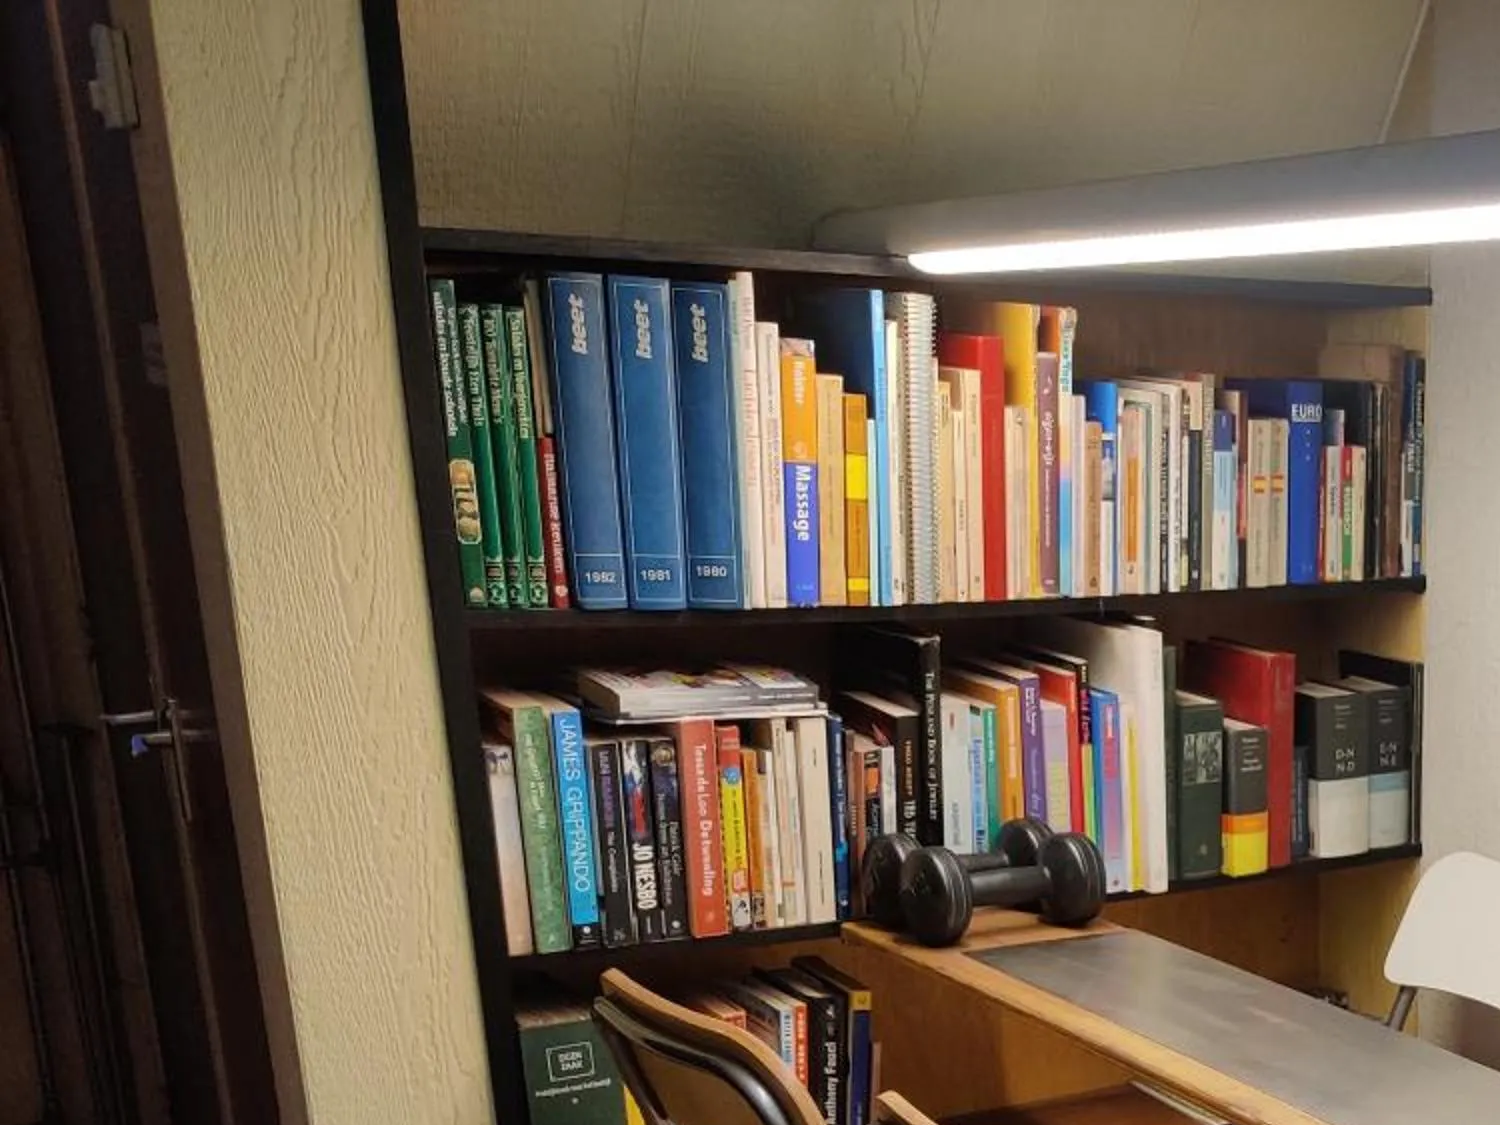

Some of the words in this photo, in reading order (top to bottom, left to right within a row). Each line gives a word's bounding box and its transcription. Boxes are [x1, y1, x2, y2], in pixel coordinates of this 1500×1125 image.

[793, 464, 811, 542] Massage
[559, 718, 581, 783] JAMES
[567, 786, 592, 894] GRIPPANDO
